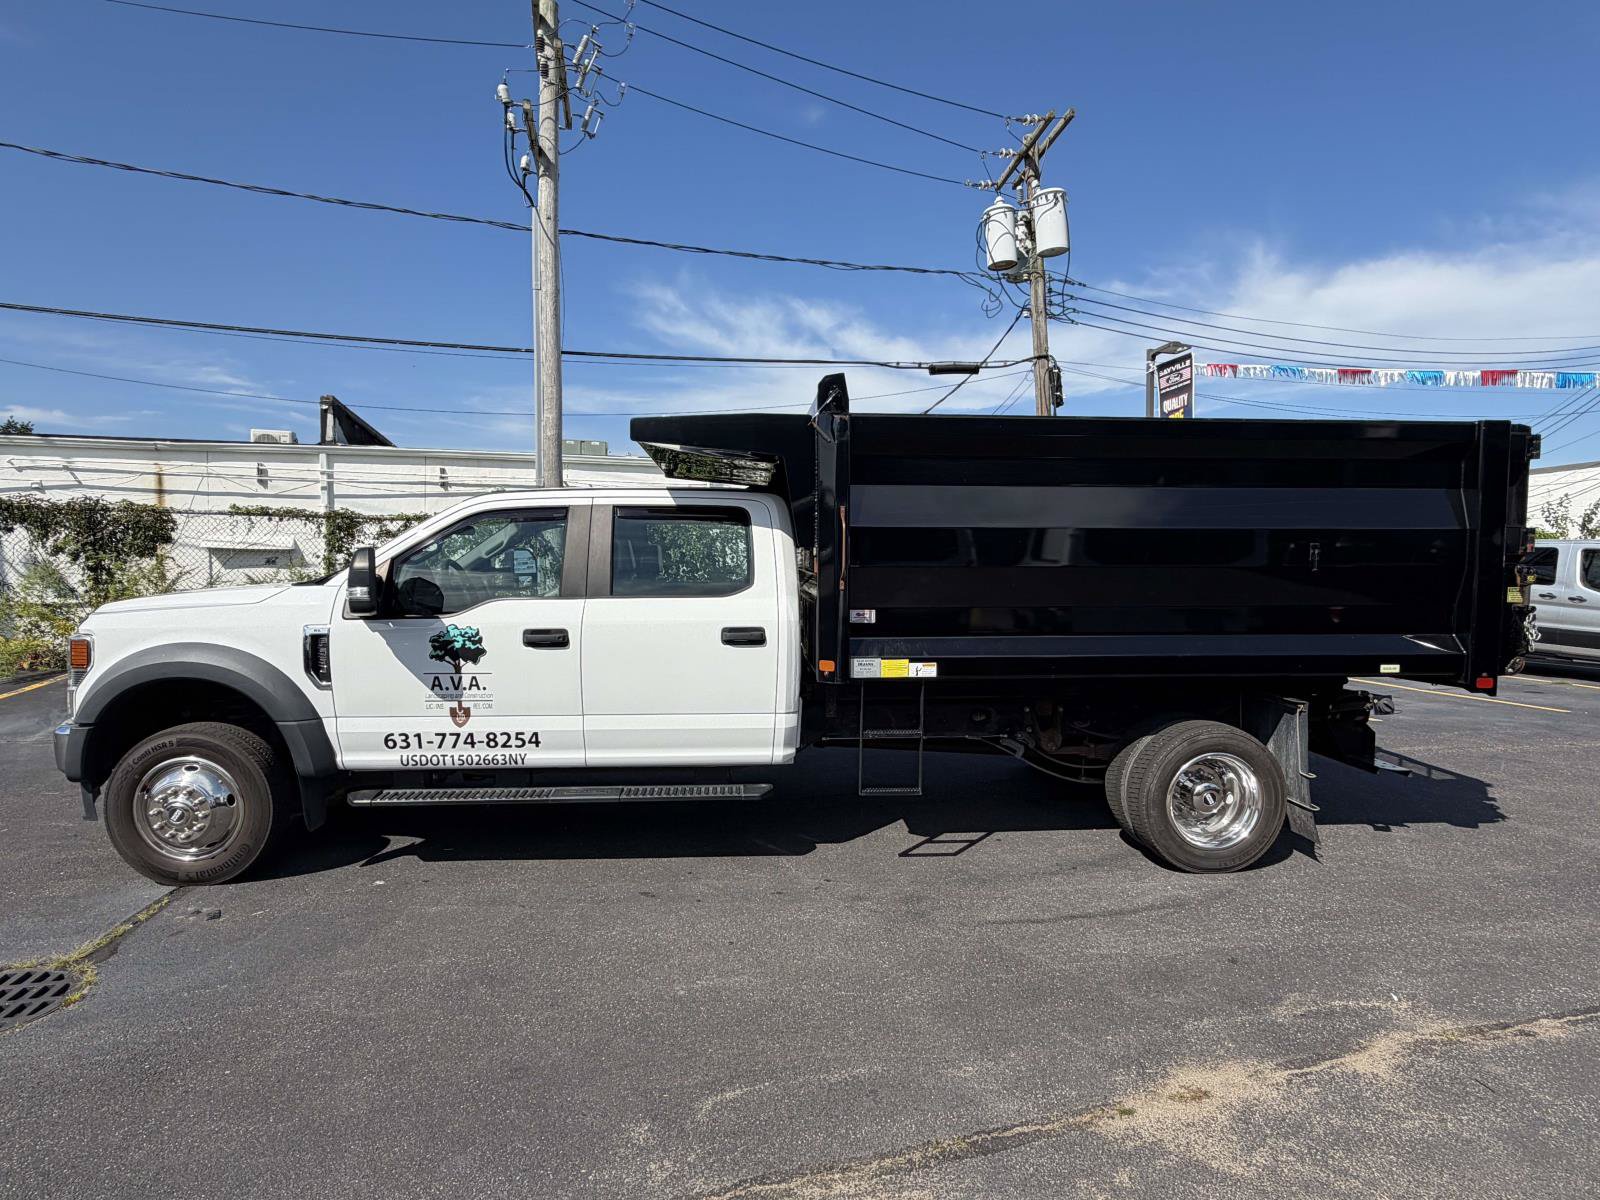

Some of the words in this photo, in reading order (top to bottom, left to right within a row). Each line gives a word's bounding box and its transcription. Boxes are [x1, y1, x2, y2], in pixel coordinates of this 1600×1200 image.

[1159, 359, 1191, 377] SAYVILLE
[1163, 393, 1189, 414] QUALITY
[430, 675, 487, 691] A.V.A.
[384, 731, 541, 750] 631-774-8254
[132, 748, 152, 766] Conti
[151, 741, 168, 755] HSR
[400, 753, 528, 767] USDOT1502663NY
[196, 843, 251, 880] Continental
